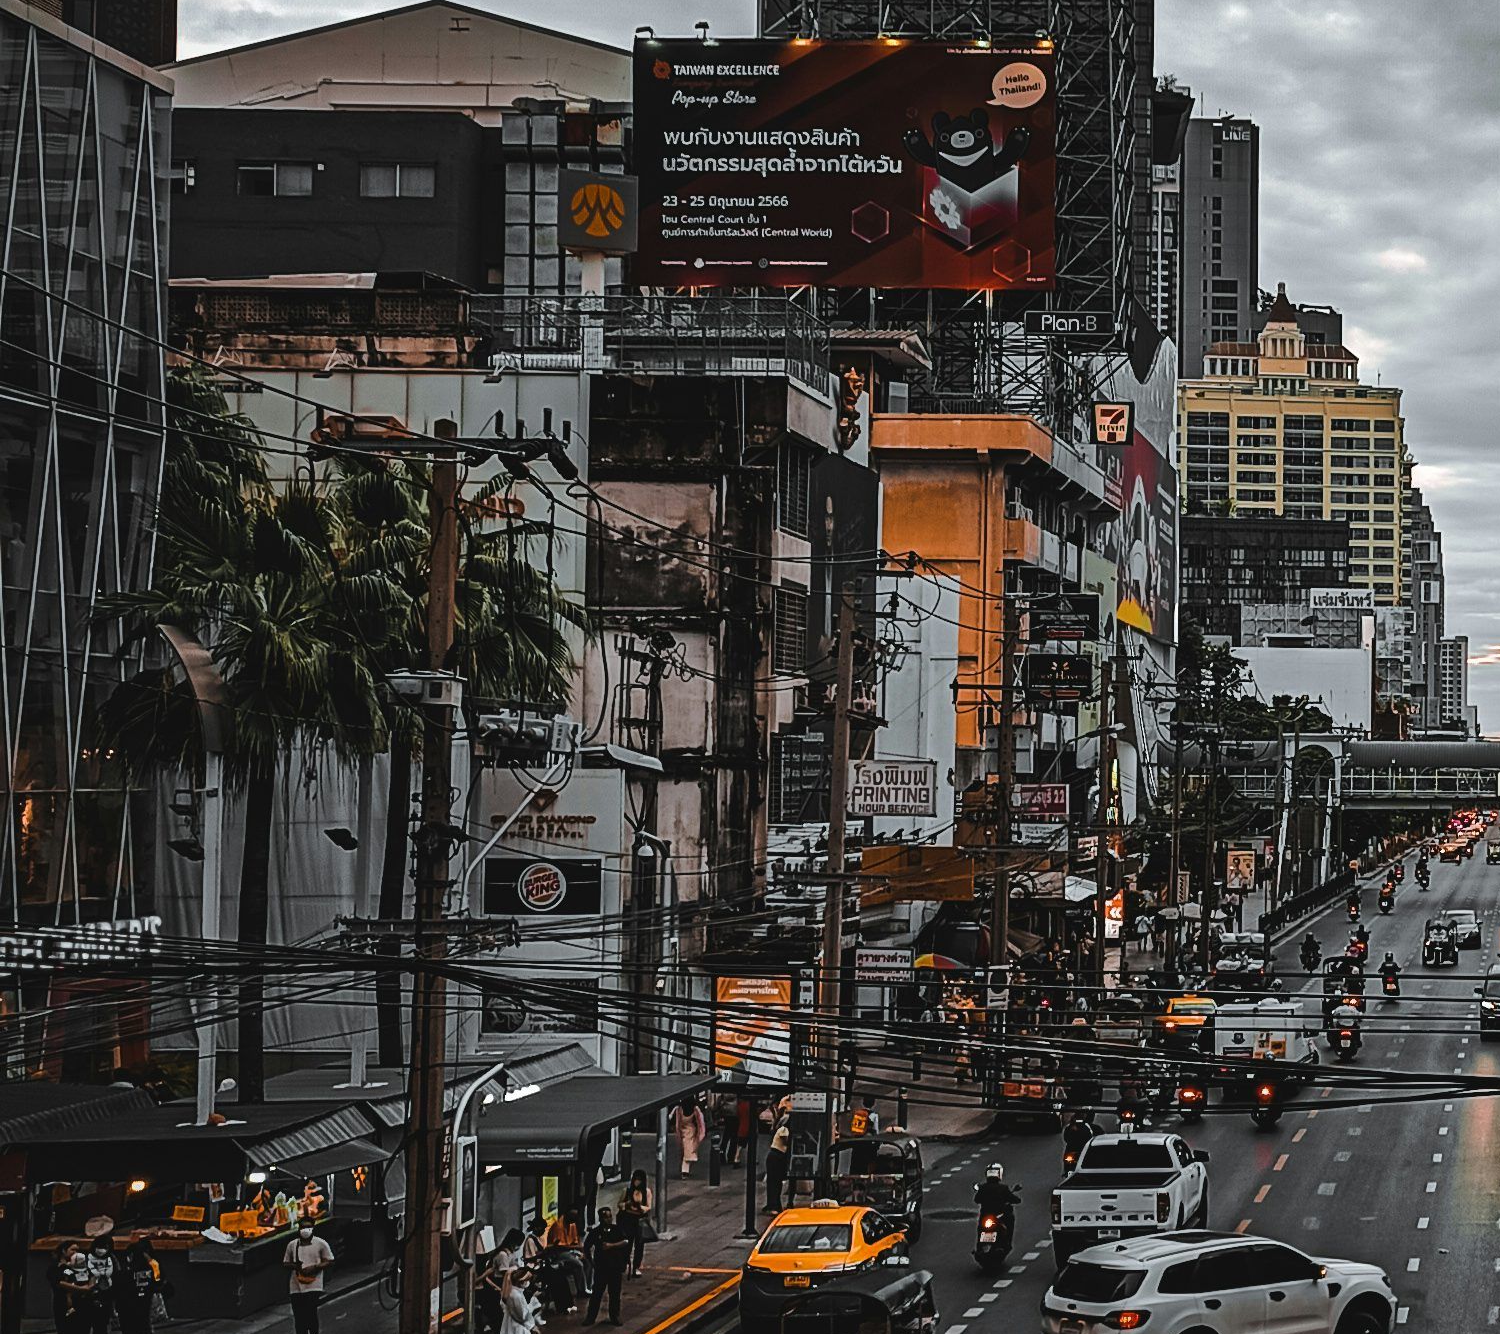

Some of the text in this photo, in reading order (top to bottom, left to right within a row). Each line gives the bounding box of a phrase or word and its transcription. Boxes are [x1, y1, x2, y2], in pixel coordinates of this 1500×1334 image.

[673, 65, 780, 75] TAIWAN EXCELLENCE
[1005, 74, 1030, 84] Hello
[999, 83, 1041, 95] Thailand!
[671, 89, 757, 108] Pop-up Store
[663, 127, 860, 147] พบกับงานแสดงสินค้า
[1222, 131, 1251, 140] LINE
[662, 148, 903, 178] นวัตกรรมสุดล้ำจากไต้หวัน
[662, 196, 678, 207] 23
[690, 196, 705, 207] 25
[709, 196, 755, 210] มิถุนายน
[758, 196, 789, 207] 2566
[681, 215, 715, 224] Central
[718, 215, 744, 224] Court
[853, 764, 929, 786] โรงพิมพ์
[852, 787, 930, 803] PRINTING
[1053, 789, 1065, 804] 22
[858, 804, 885, 813] HOUR
[888, 805, 930, 814] SERVICE
[536, 815, 597, 824] DIAMOND
[524, 872, 559, 889] BURGER
[526, 880, 560, 899] KING
[1063, 1214, 1155, 1222] RANGER
